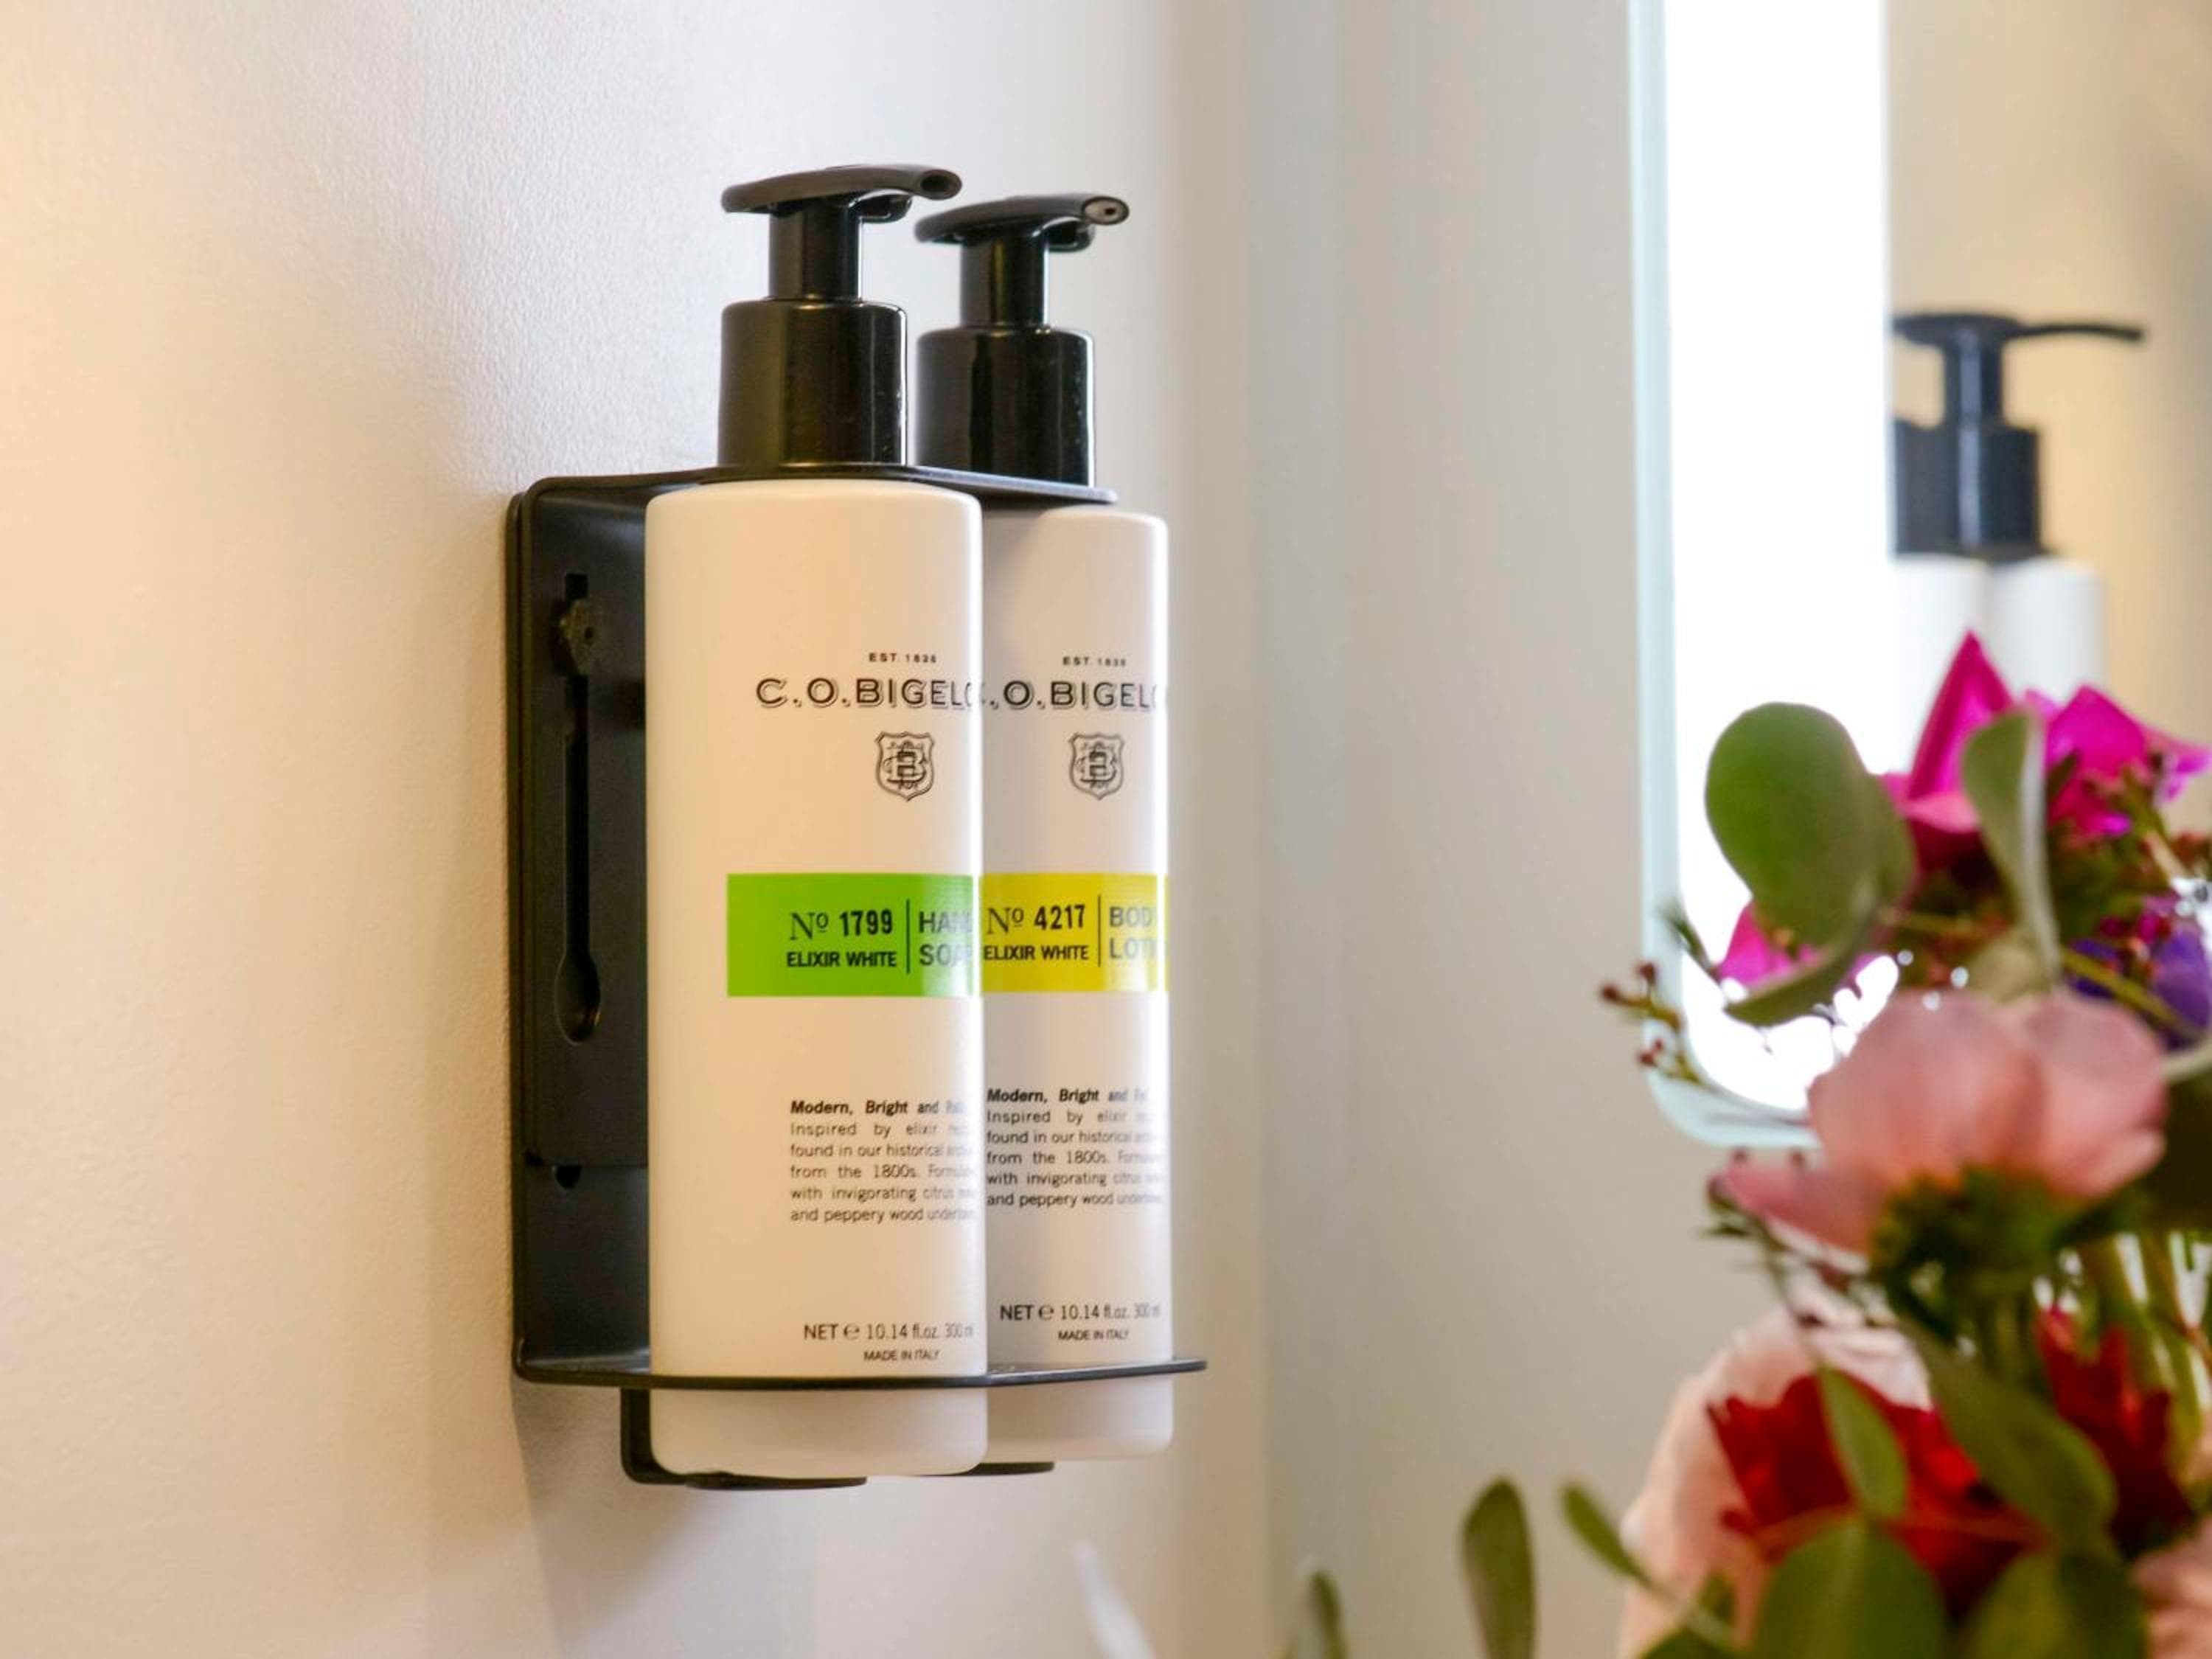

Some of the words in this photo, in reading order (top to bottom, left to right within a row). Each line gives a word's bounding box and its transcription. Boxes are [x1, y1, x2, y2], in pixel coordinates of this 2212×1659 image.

[839, 908, 893, 936] 1799
[1034, 904, 1085, 931] 4217
[787, 951, 840, 967] ELIXIR
[846, 951, 897, 967] WHITE
[984, 945, 1035, 961] ELIXIR
[1040, 945, 1089, 960] WHITE
[987, 1088, 1048, 1104] Modern,
[1059, 1088, 1099, 1104] Bright
[1108, 1089, 1127, 1102] and
[790, 1100, 853, 1116] Modern,
[866, 1099, 908, 1116] Bright
[917, 1101, 939, 1114] and
[987, 1110, 1051, 1125] Inspired
[1067, 1110, 1083, 1125] by
[791, 1122, 857, 1137] Inspired
[874, 1123, 891, 1138] by
[987, 1130, 1029, 1144] found
[1034, 1130, 1046, 1144] in
[1051, 1133, 1075, 1144] our
[790, 1144, 833, 1157] found
[839, 1144, 852, 1157] in
[858, 1147, 880, 1157] our
[987, 1151, 1022, 1164] from
[1033, 1151, 1055, 1164] the
[790, 1164, 826, 1178] from
[838, 1164, 861, 1178] the
[987, 1172, 1018, 1185] with
[1026, 1172, 1107, 1189] invigorating
[791, 1186, 822, 1200] with
[832, 1186, 917, 1203] invigorating
[987, 1193, 1014, 1206] and
[1019, 1194, 1077, 1208] peppery
[1083, 1193, 1113, 1205] wood
[791, 1208, 818, 1221] and
[824, 1209, 884, 1224] peppery
[889, 1208, 923, 1221] wood
[1000, 1304, 1034, 1321] NET
[1060, 1304, 1100, 1321] 10.14
[804, 1324, 839, 1340] NET
[867, 1324, 908, 1340] 10.14
[1058, 1329, 1088, 1340] MADE
[1092, 1329, 1104, 1340] IN
[1106, 1329, 1130, 1340] ITALY
[863, 1349, 897, 1361] MADE
[901, 1349, 912, 1360] IN
[914, 1349, 941, 1360] ITALY
